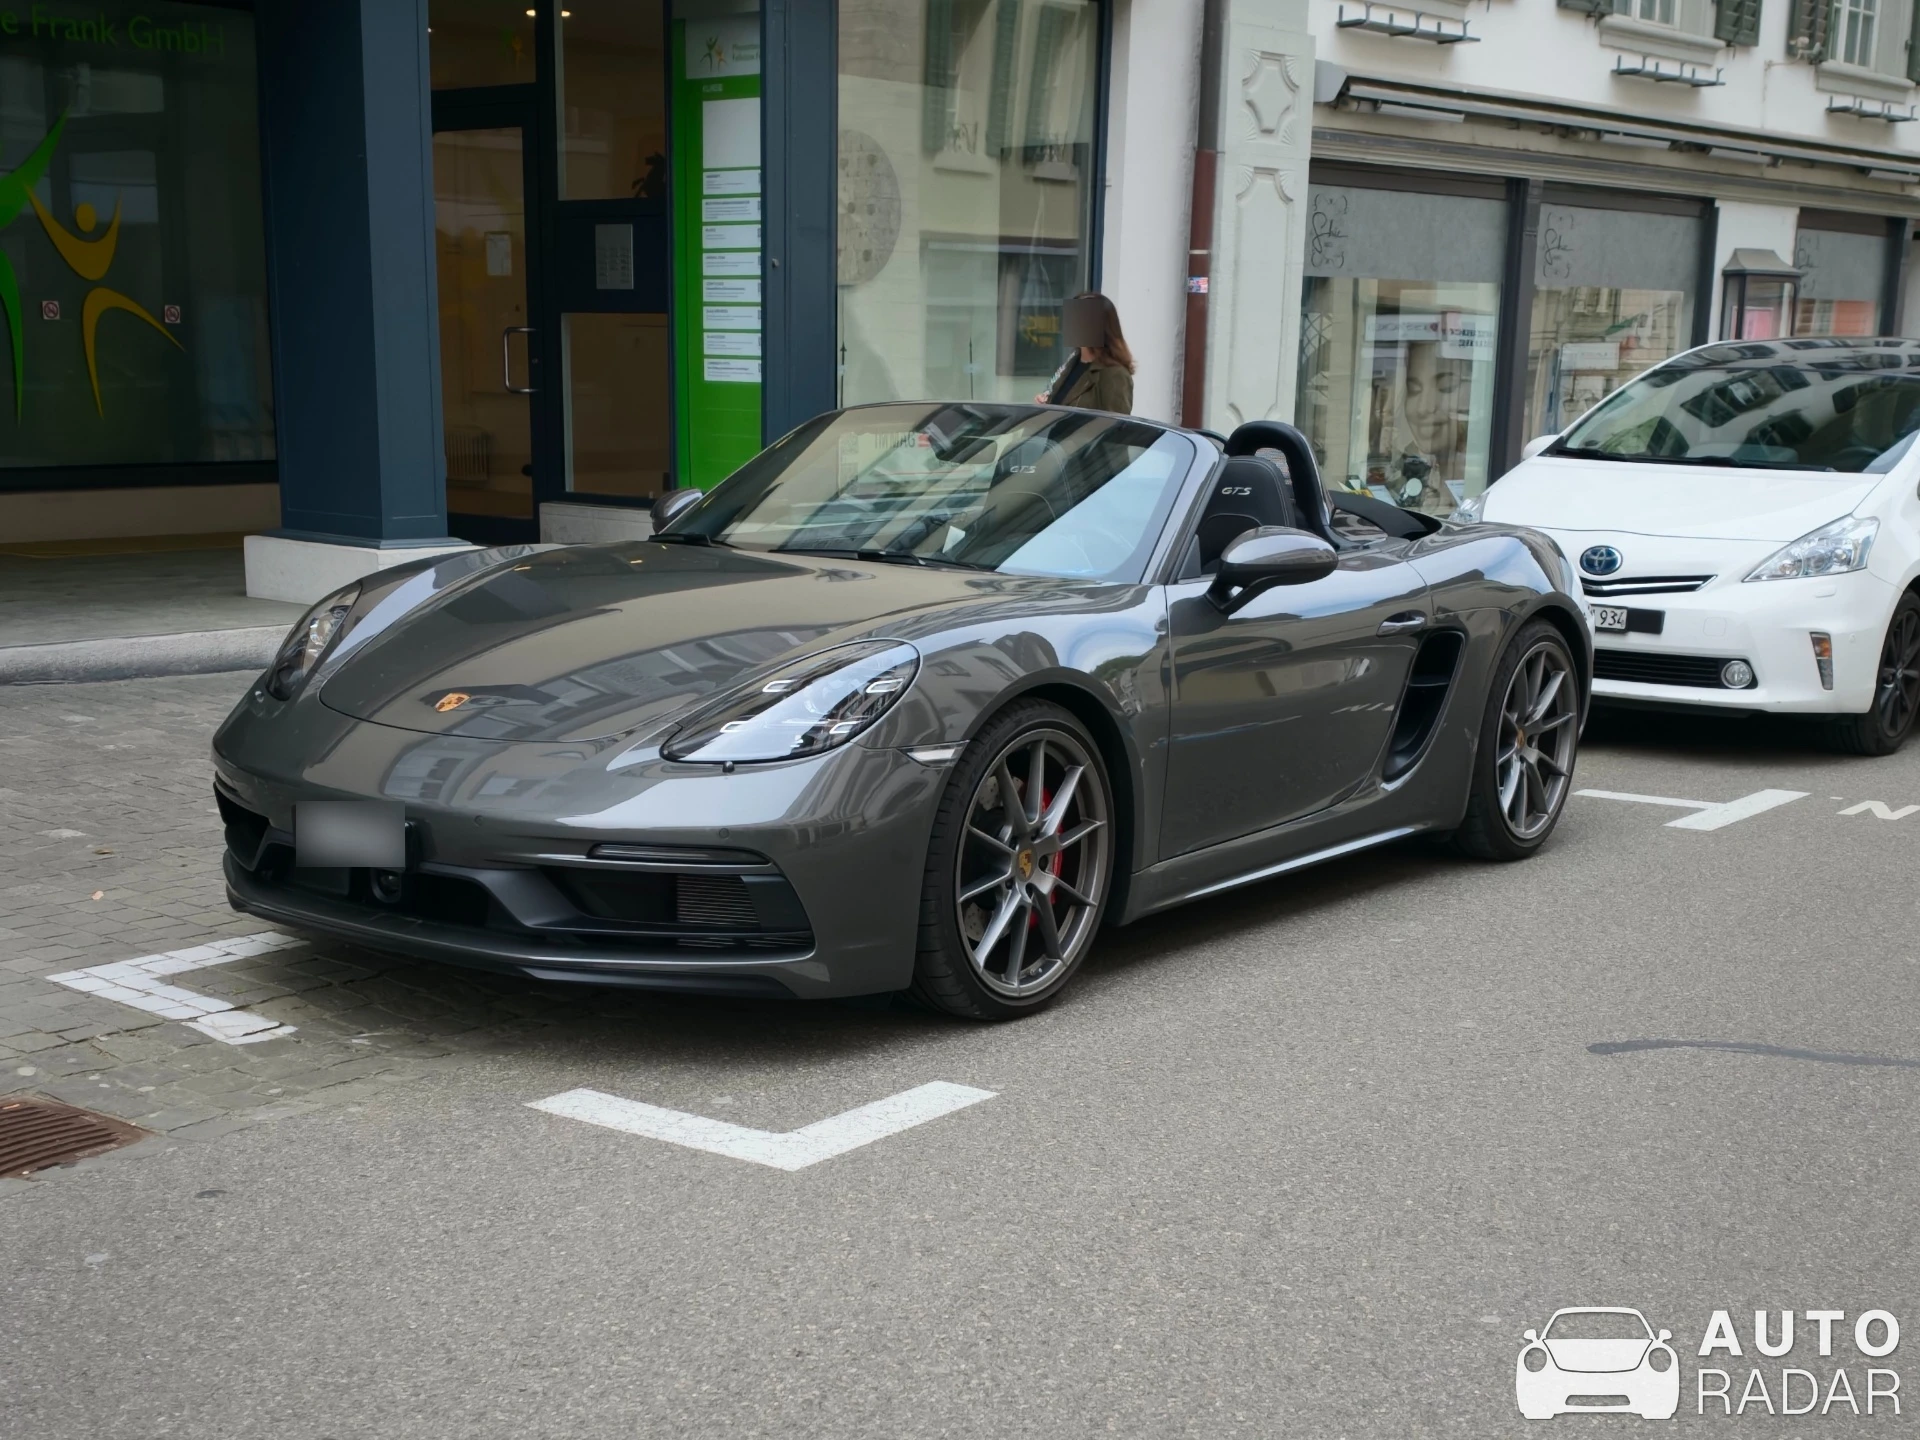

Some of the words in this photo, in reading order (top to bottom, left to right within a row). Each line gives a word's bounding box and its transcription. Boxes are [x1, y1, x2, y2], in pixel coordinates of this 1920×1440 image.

[31, 4, 118, 48] Frank
[128, 15, 225, 57] GmbH
[1010, 465, 1036, 474] GTS
[1221, 486, 1252, 496] GTS
